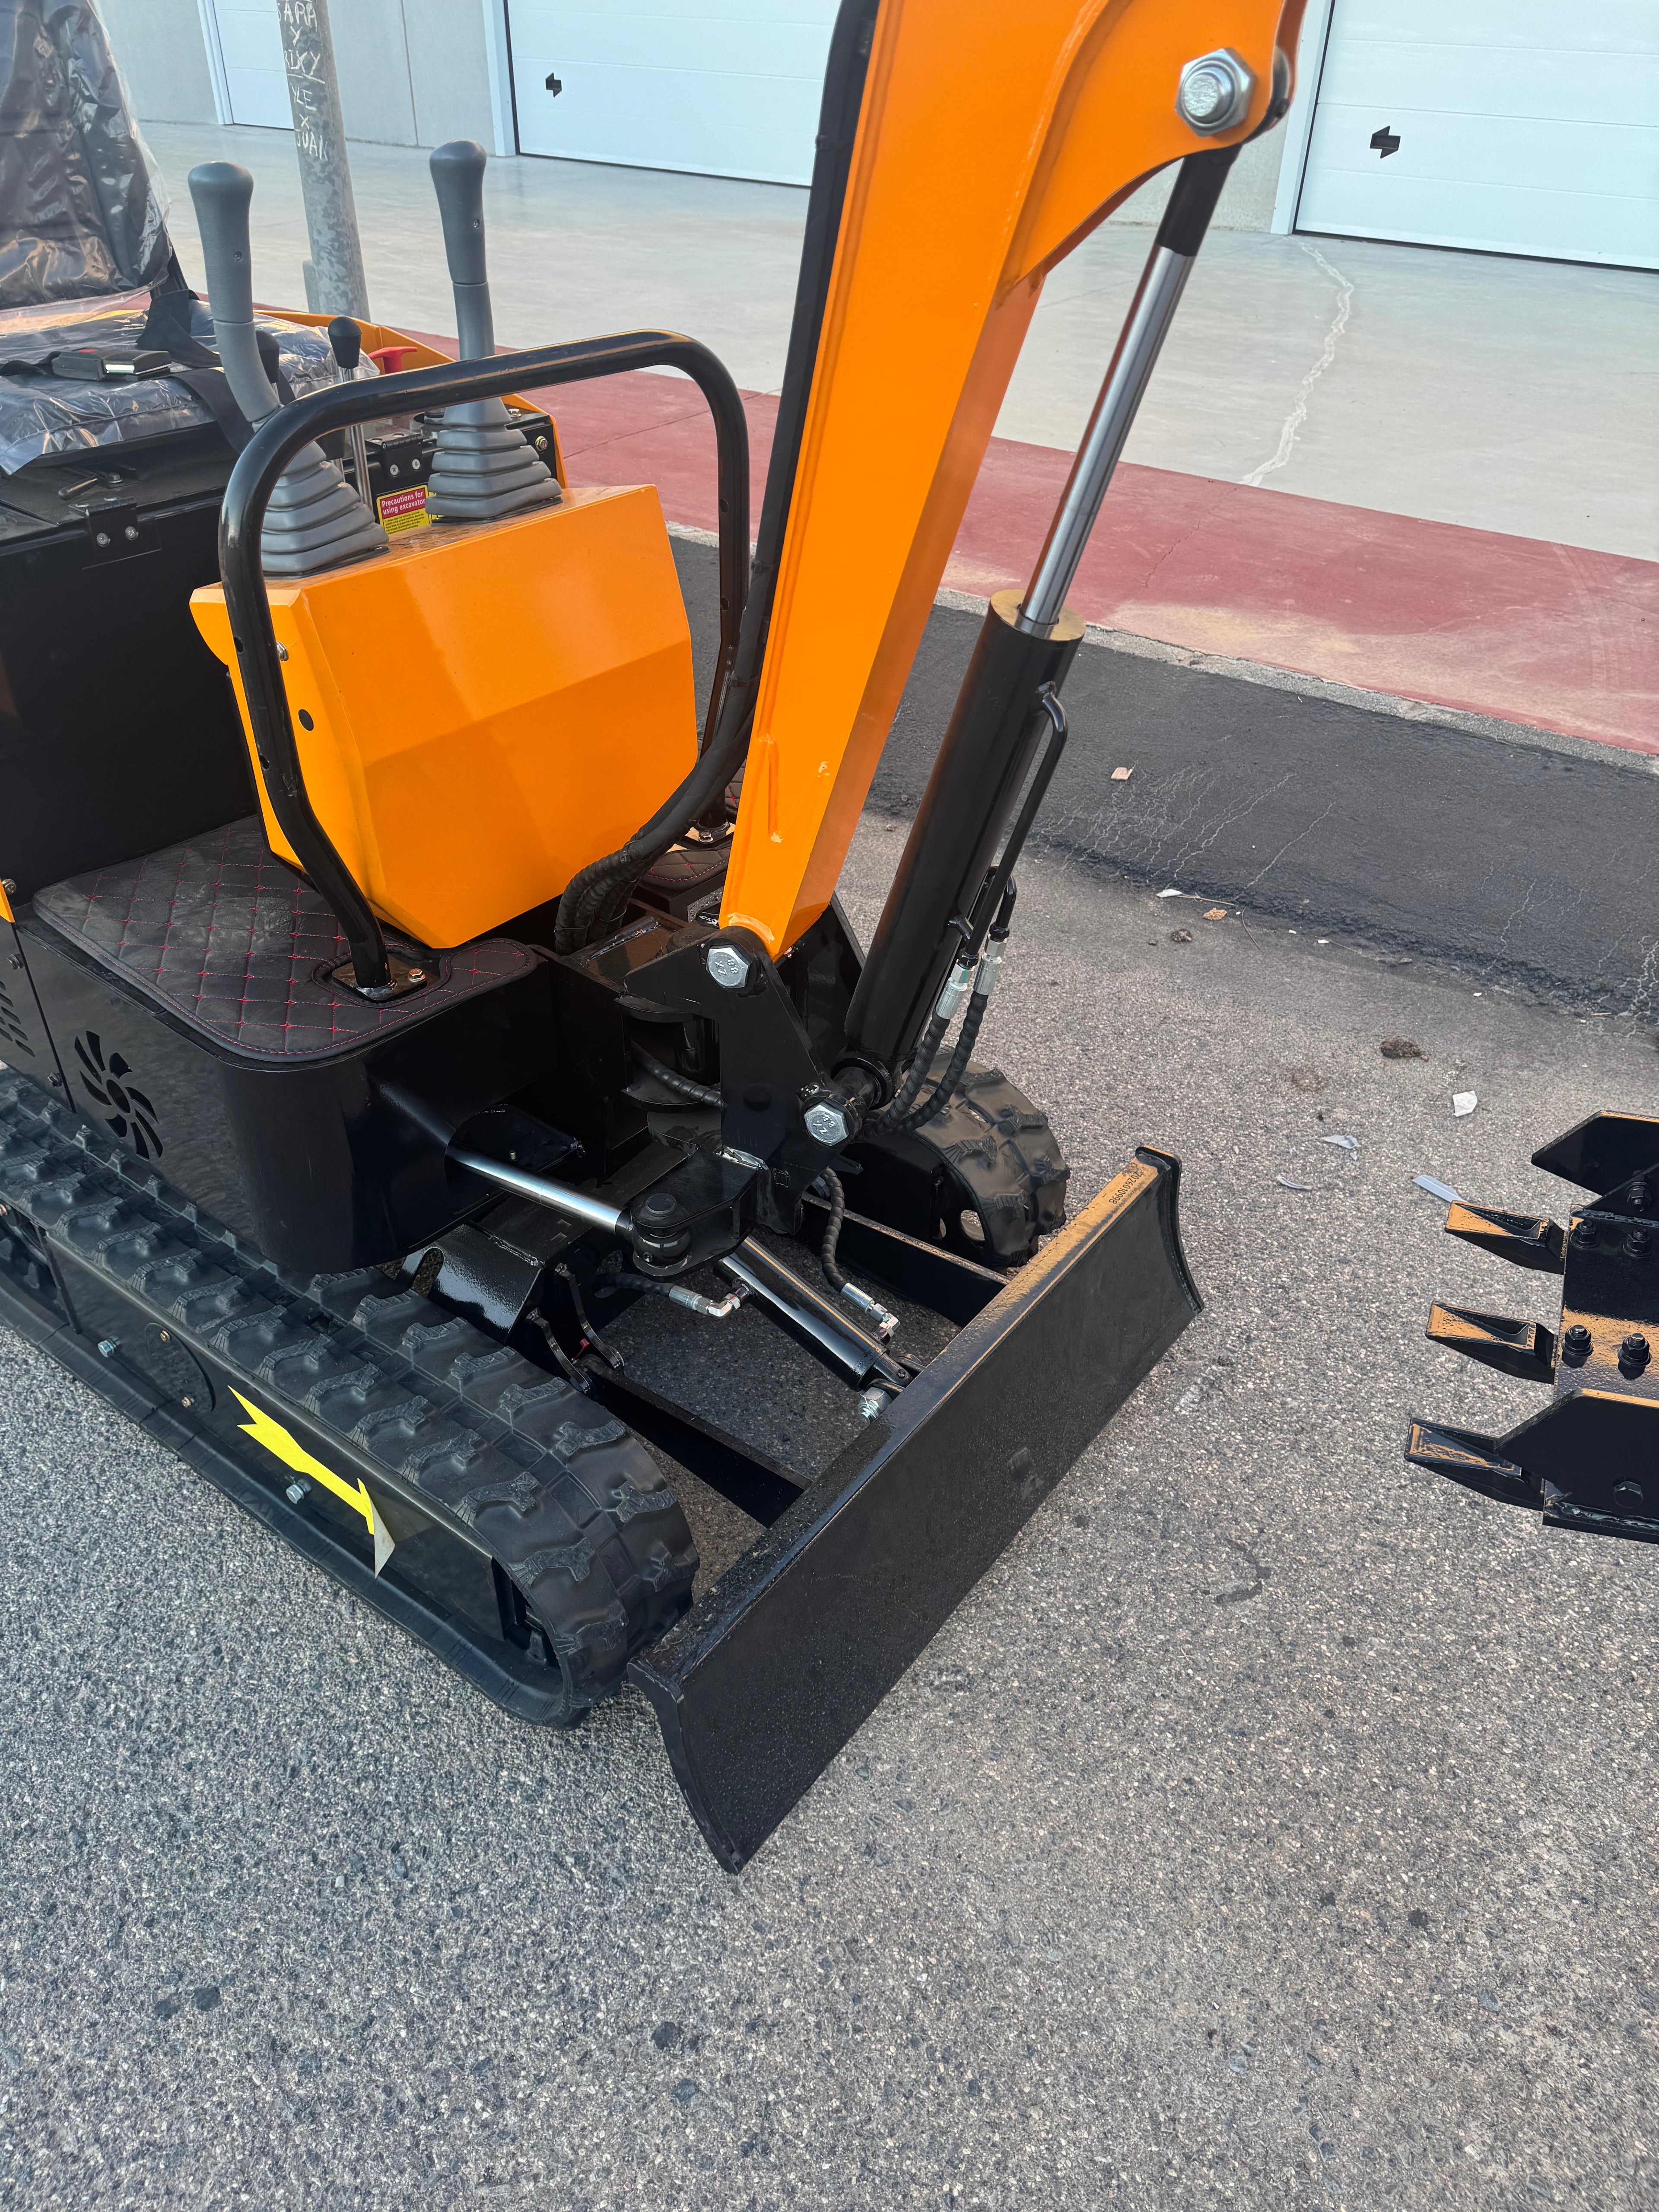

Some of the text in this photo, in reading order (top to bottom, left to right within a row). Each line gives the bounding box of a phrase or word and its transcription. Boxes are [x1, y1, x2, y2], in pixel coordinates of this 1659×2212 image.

[290, 26, 302, 46] Y
[381, 494, 414, 508] Precautions
[399, 499, 425, 511] excavator
[1109, 1172, 1143, 1204] 2026010998
